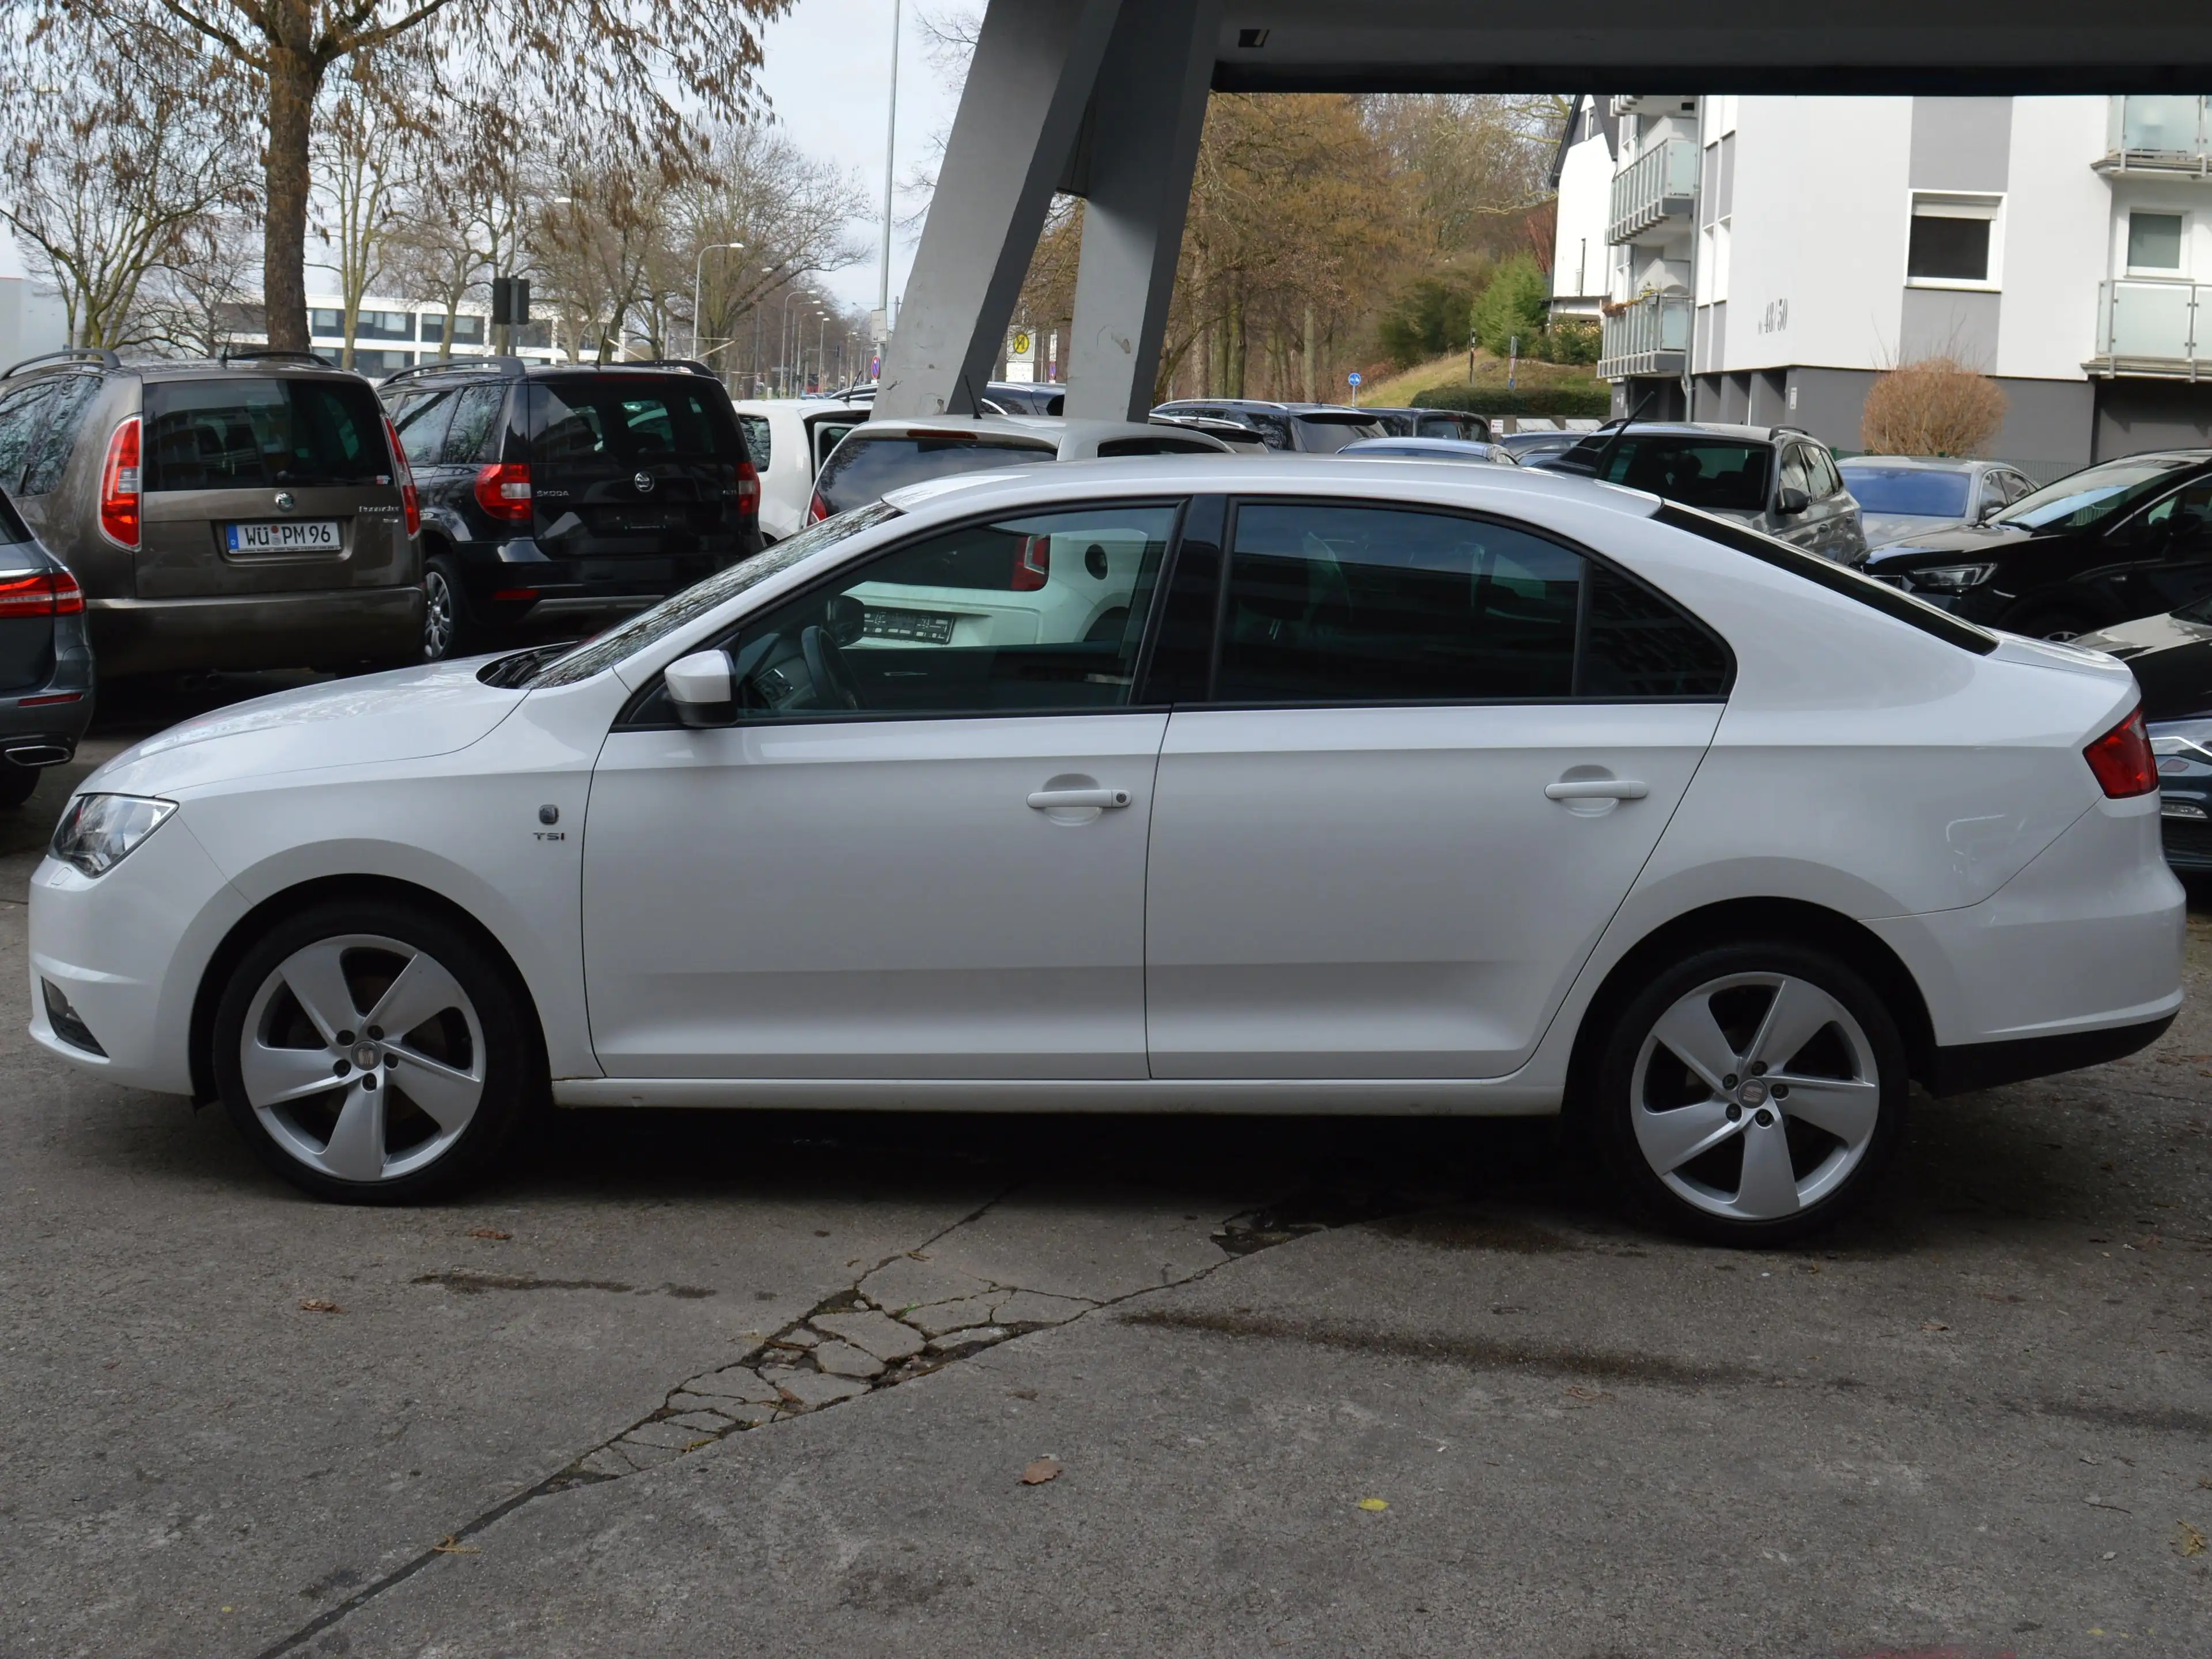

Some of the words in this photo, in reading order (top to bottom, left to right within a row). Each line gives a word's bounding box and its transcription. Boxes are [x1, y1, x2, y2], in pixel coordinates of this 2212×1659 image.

[244, 527, 270, 546] WÜ
[281, 525, 306, 544] PM
[308, 524, 331, 543] 96
[533, 832, 565, 840] TSI
